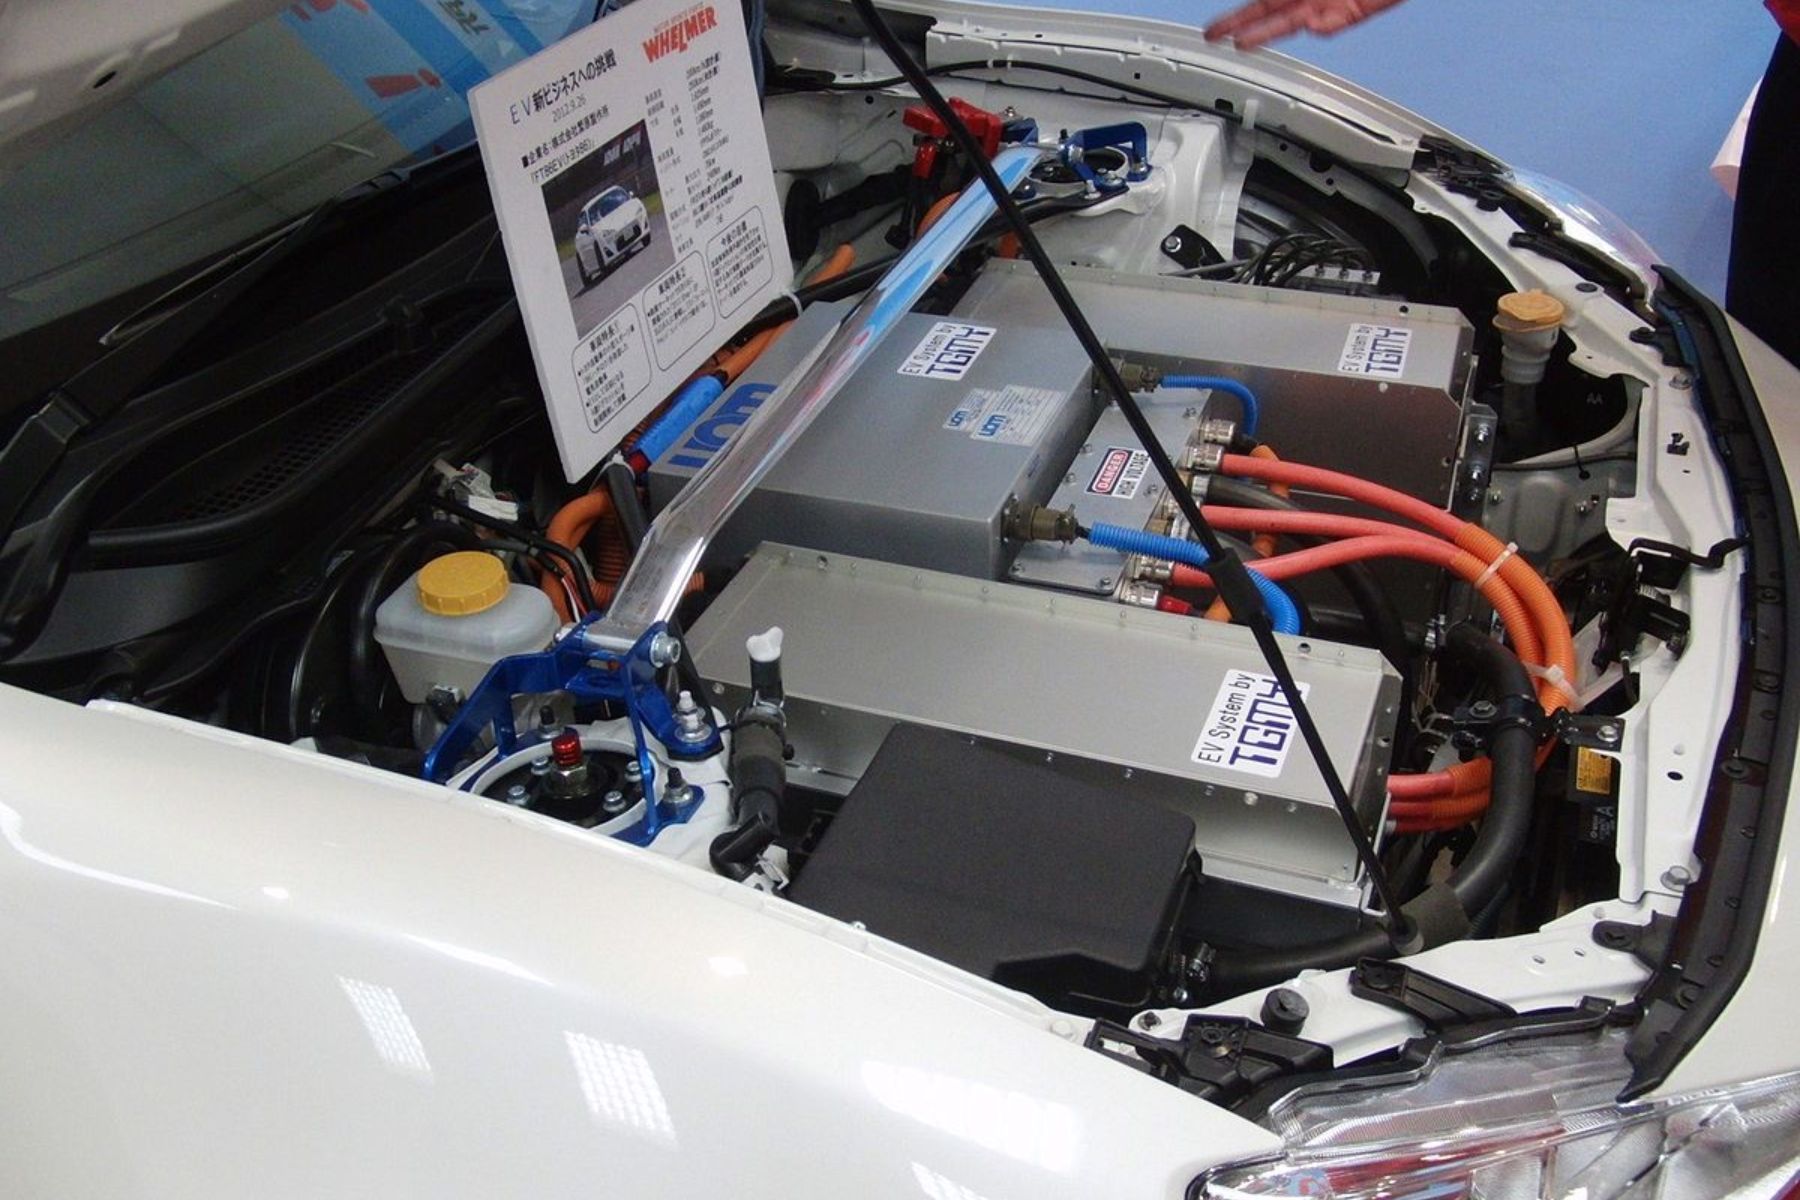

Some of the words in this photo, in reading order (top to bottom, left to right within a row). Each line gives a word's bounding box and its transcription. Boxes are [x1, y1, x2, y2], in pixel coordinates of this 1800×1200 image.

[643, 6, 717, 63] WHELMER
[902, 362, 923, 374] EV
[913, 335, 947, 360] System
[935, 324, 956, 333] by
[1346, 335, 1369, 360] System
[1341, 361, 1360, 372] EV
[1097, 453, 1125, 489] DANGER
[1123, 453, 1149, 479] VOLTAGE
[1114, 480, 1138, 496] HIGH
[1228, 673, 1256, 690] by
[1208, 692, 1247, 739] System
[1198, 741, 1225, 763] EV
